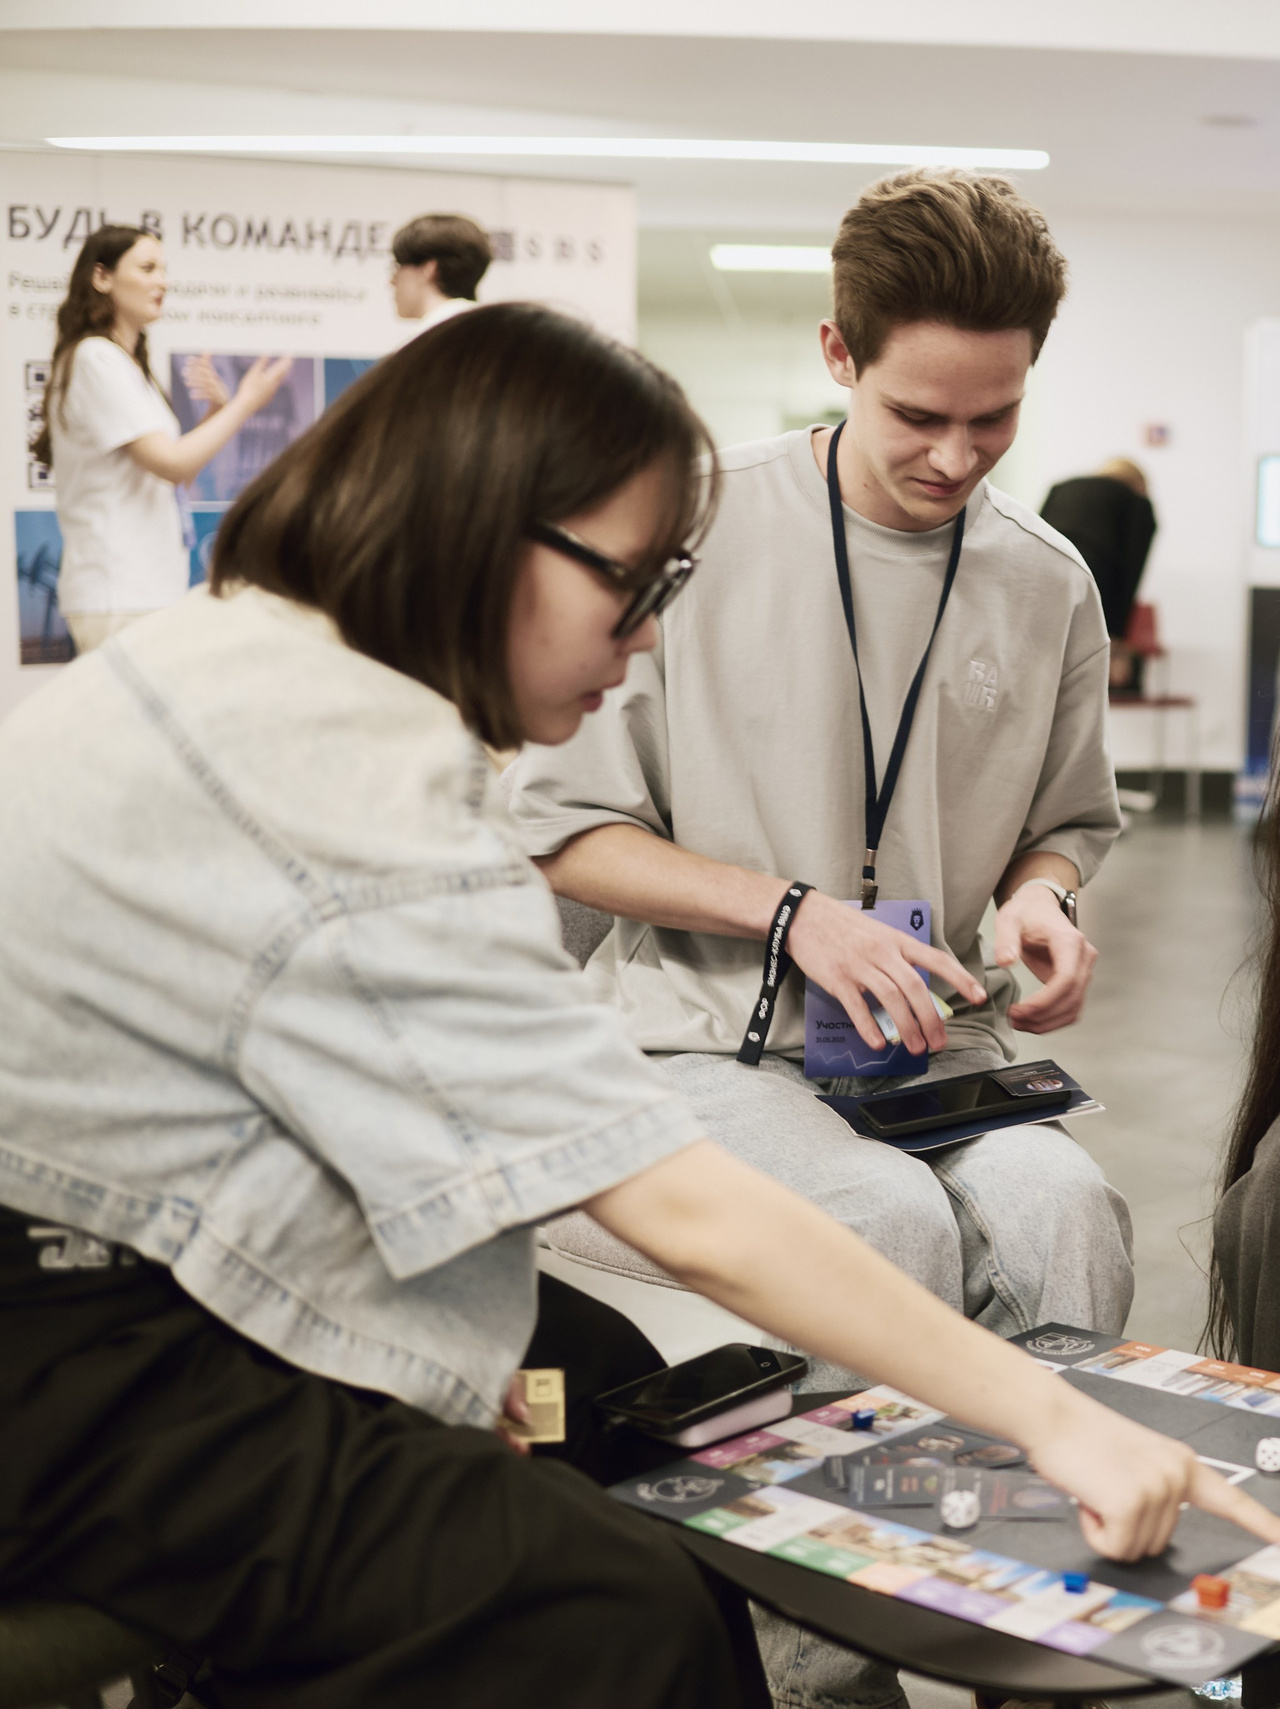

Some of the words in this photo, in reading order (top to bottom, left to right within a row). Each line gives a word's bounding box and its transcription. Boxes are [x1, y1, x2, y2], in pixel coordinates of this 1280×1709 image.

[181, 214, 390, 261] КОМАНДЕ
[767, 926, 784, 988] БИЗНЕС-КЛУБА
[777, 904, 792, 927] ВШЭ
